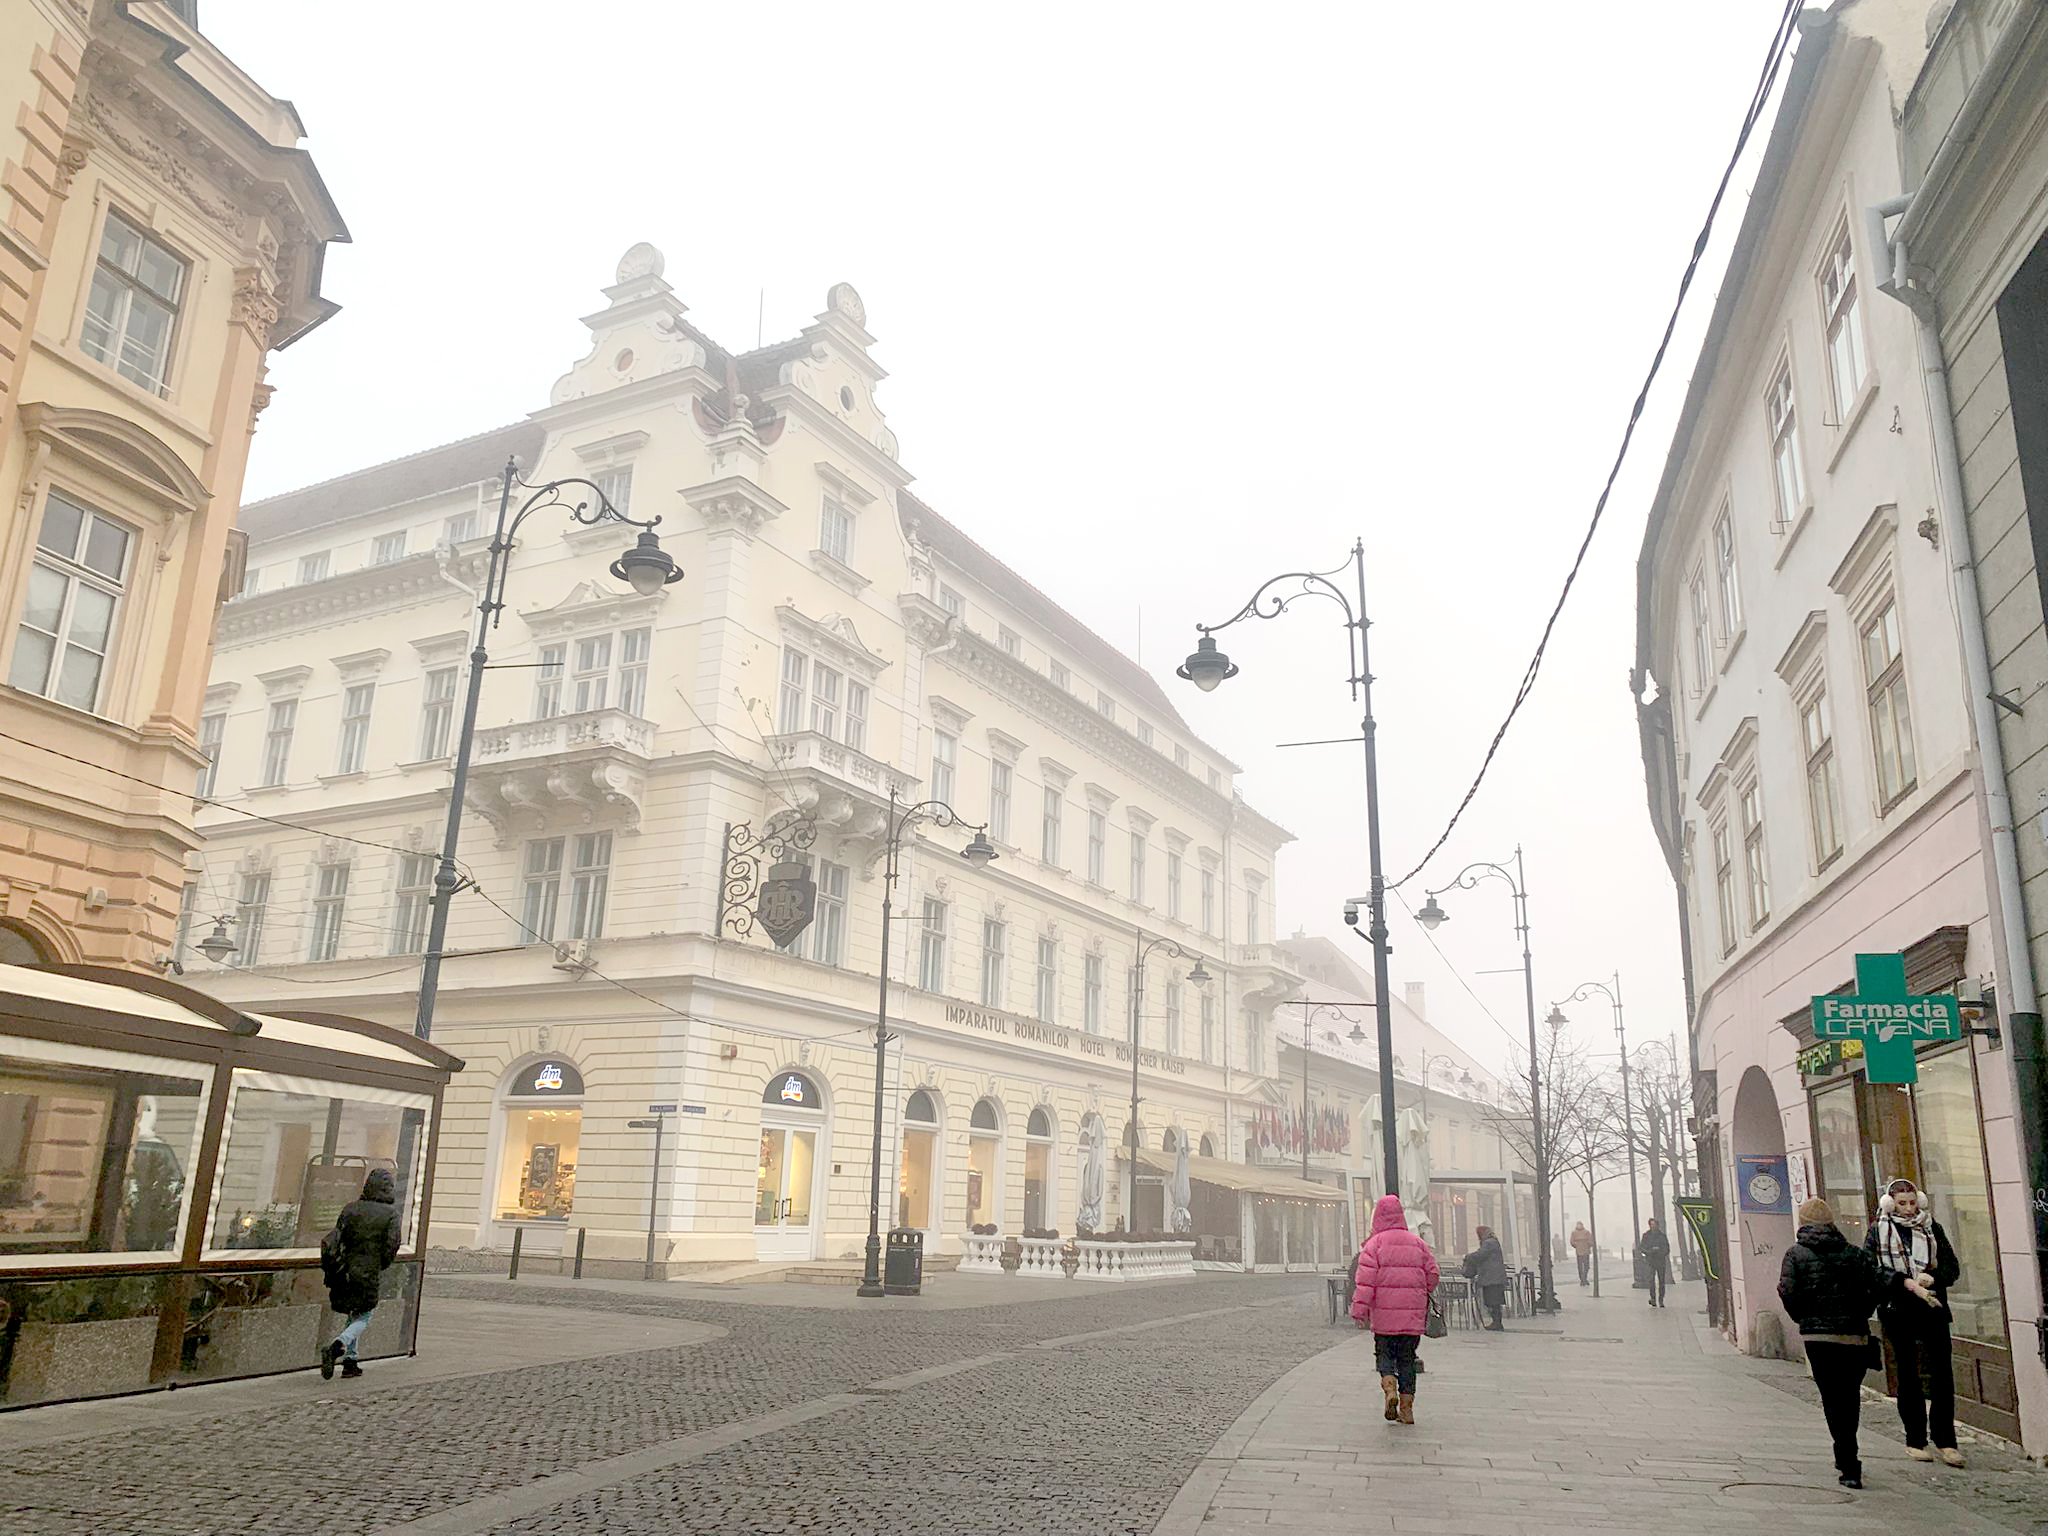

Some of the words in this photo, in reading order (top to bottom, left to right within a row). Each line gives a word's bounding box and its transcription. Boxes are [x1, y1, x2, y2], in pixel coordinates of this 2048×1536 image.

[1823, 998, 1949, 1018] Farmacia
[1825, 1018, 1951, 1036] CATENA
[945, 1004, 1008, 1034] IMPARATUL
[1014, 1021, 1069, 1049] ROMANILOR
[1080, 1037, 1106, 1057] HOTEL
[1115, 1045, 1158, 1069] RÖMSCHER
[1161, 1057, 1185, 1076] KAISER
